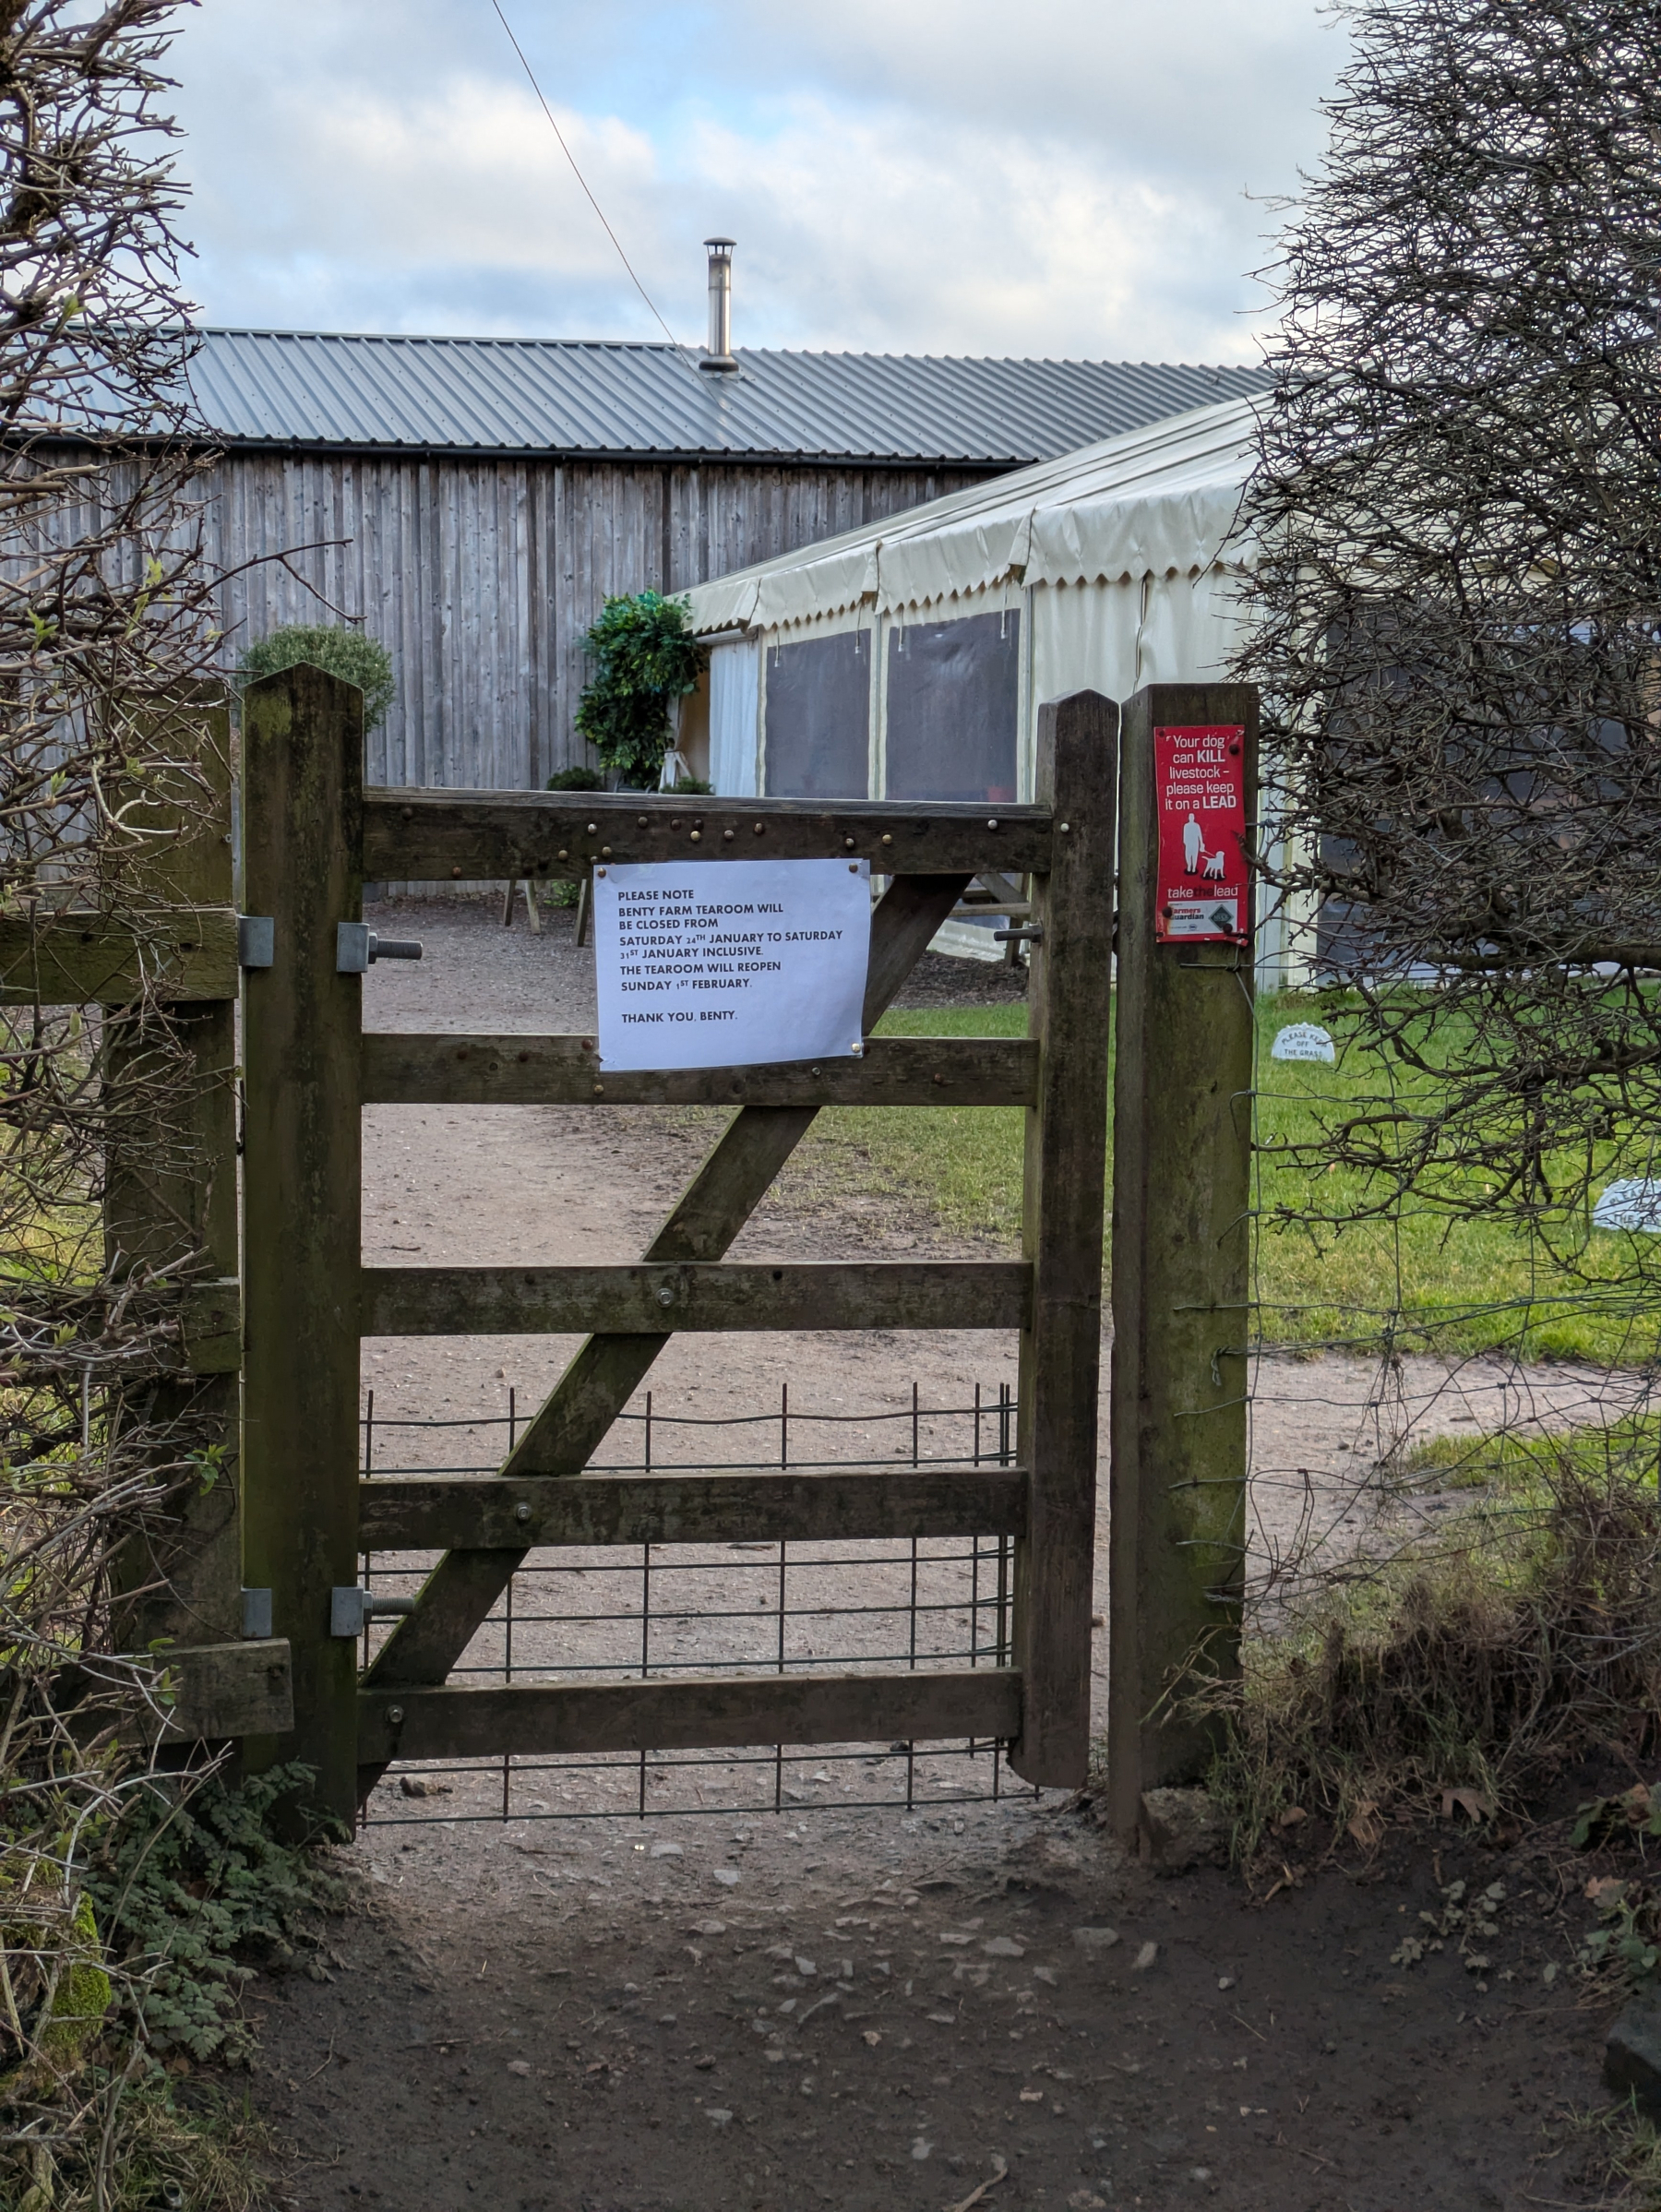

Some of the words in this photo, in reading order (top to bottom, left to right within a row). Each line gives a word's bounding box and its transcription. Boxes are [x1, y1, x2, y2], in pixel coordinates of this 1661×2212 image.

[1173, 735, 1200, 748] Your
[1202, 734, 1225, 749] dog
[1173, 753, 1194, 764] can
[1197, 749, 1225, 763] KILL
[1169, 765, 1221, 779] livestock
[1166, 781, 1203, 797] please
[1206, 780, 1234, 795] keep
[1165, 797, 1173, 811] it
[1175, 799, 1190, 810] on
[1192, 799, 1201, 809] a
[1202, 795, 1237, 809] LEAD
[618, 891, 659, 902] PLEASE
[662, 889, 695, 900] NOTE
[618, 906, 656, 917] BENTY
[659, 905, 693, 916] FARM
[696, 903, 755, 915] TEAROOM
[757, 903, 784, 914] WILL
[618, 920, 633, 931] BE
[636, 919, 681, 930] CLOSED
[684, 917, 719, 928] FROM
[619, 935, 683, 947] SATURDAY
[686, 934, 706, 945] 24TH
[709, 932, 765, 944] JANUARY
[767, 932, 783, 943] TO
[784, 929, 843, 941] SATURDAY
[620, 949, 639, 960] 31ST
[641, 947, 699, 959] JANUARY
[702, 946, 764, 957] INCLUSIVE.
[620, 965, 642, 975] THE
[644, 963, 704, 974] TEAROOM
[706, 963, 735, 974] WILL
[737, 961, 782, 973] REOPEN
[621, 980, 673, 992] SUNDAY
[675, 979, 689, 990] 1ST
[692, 977, 753, 990] FEBRUARY.
[621, 1012, 664, 1023] THANK
[699, 1010, 738, 1022] BENTY.
[1282, 1031, 1307, 1046] PLEASE
